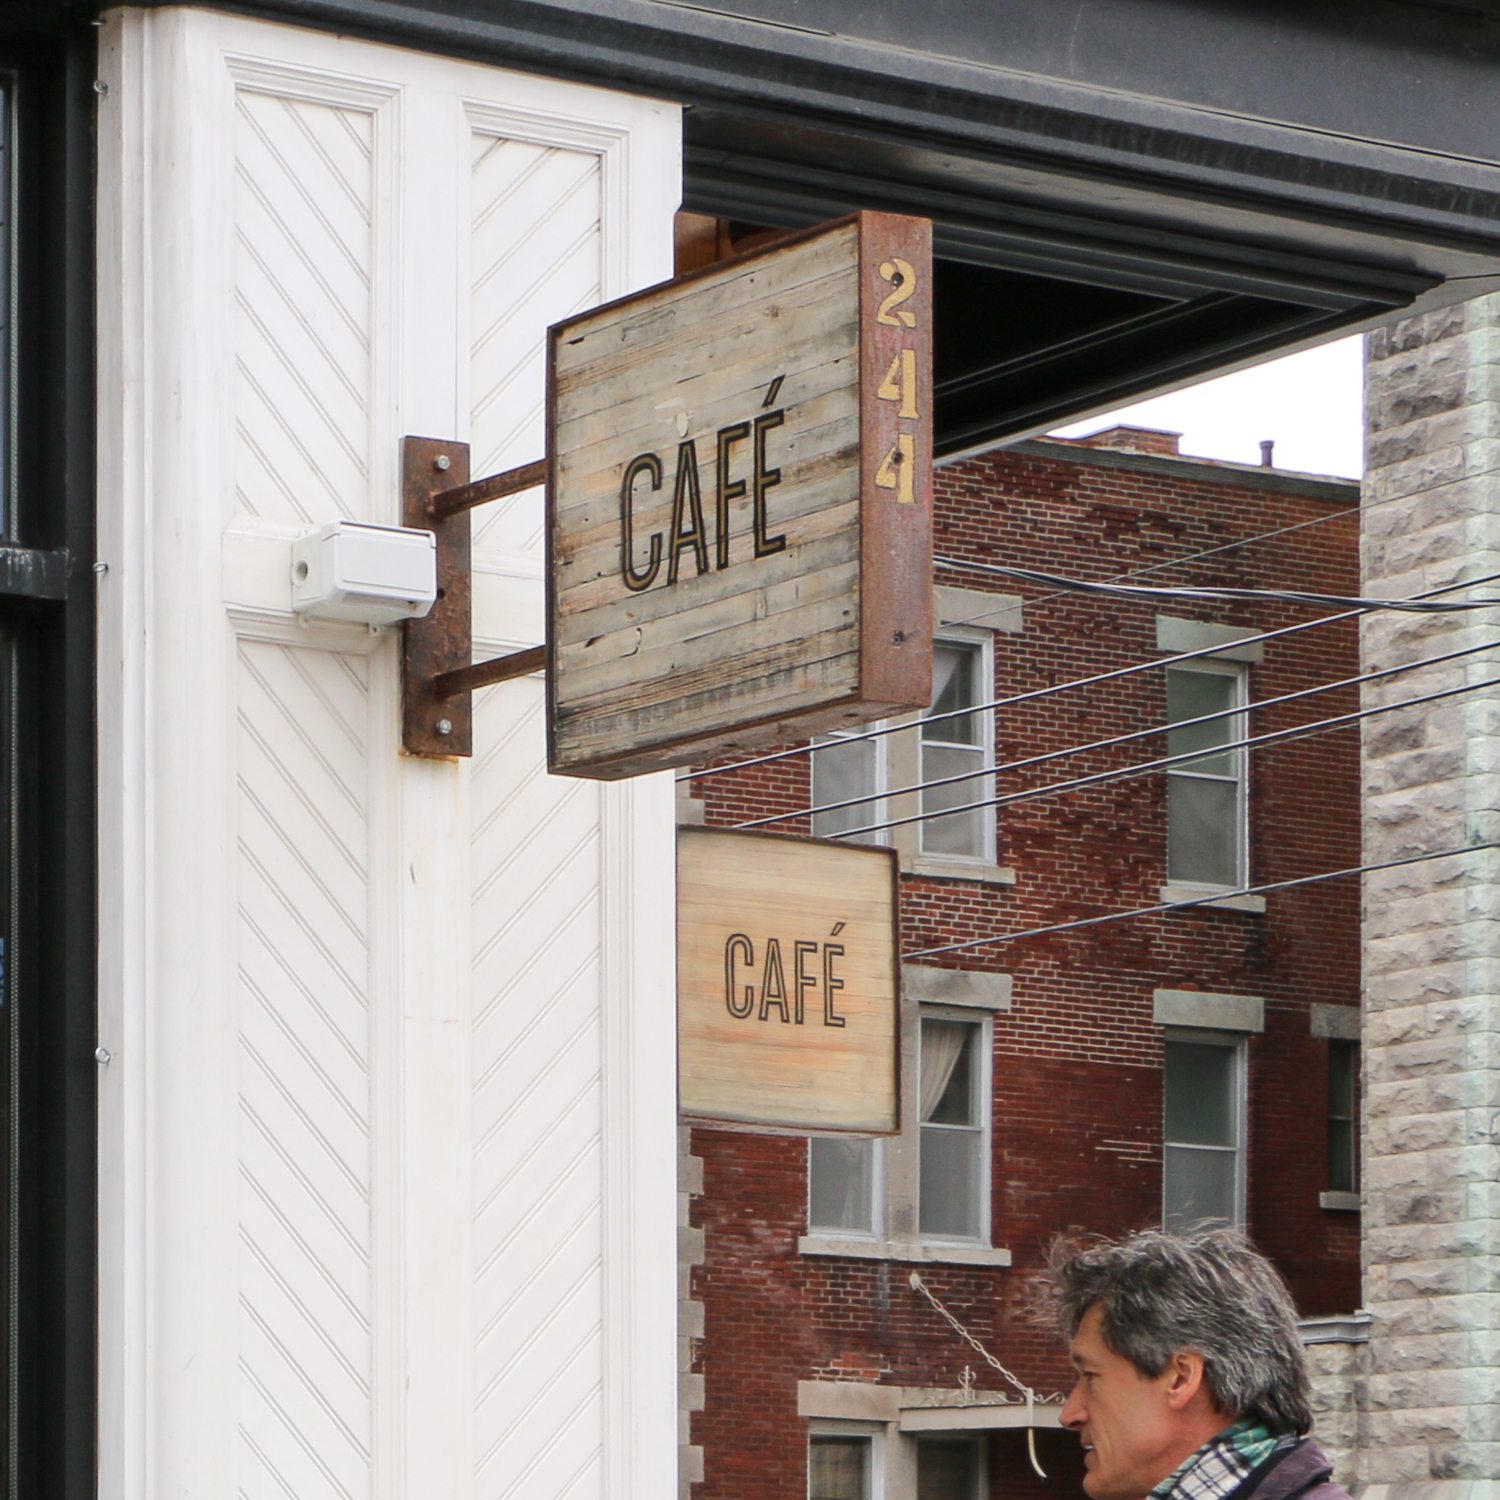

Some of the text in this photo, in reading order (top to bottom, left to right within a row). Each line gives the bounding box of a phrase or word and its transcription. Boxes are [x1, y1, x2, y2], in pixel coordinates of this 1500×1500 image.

[620, 374, 787, 592] CAFÉ
[875, 257, 920, 504] 244
[723, 922, 847, 1029] CAFÉ
